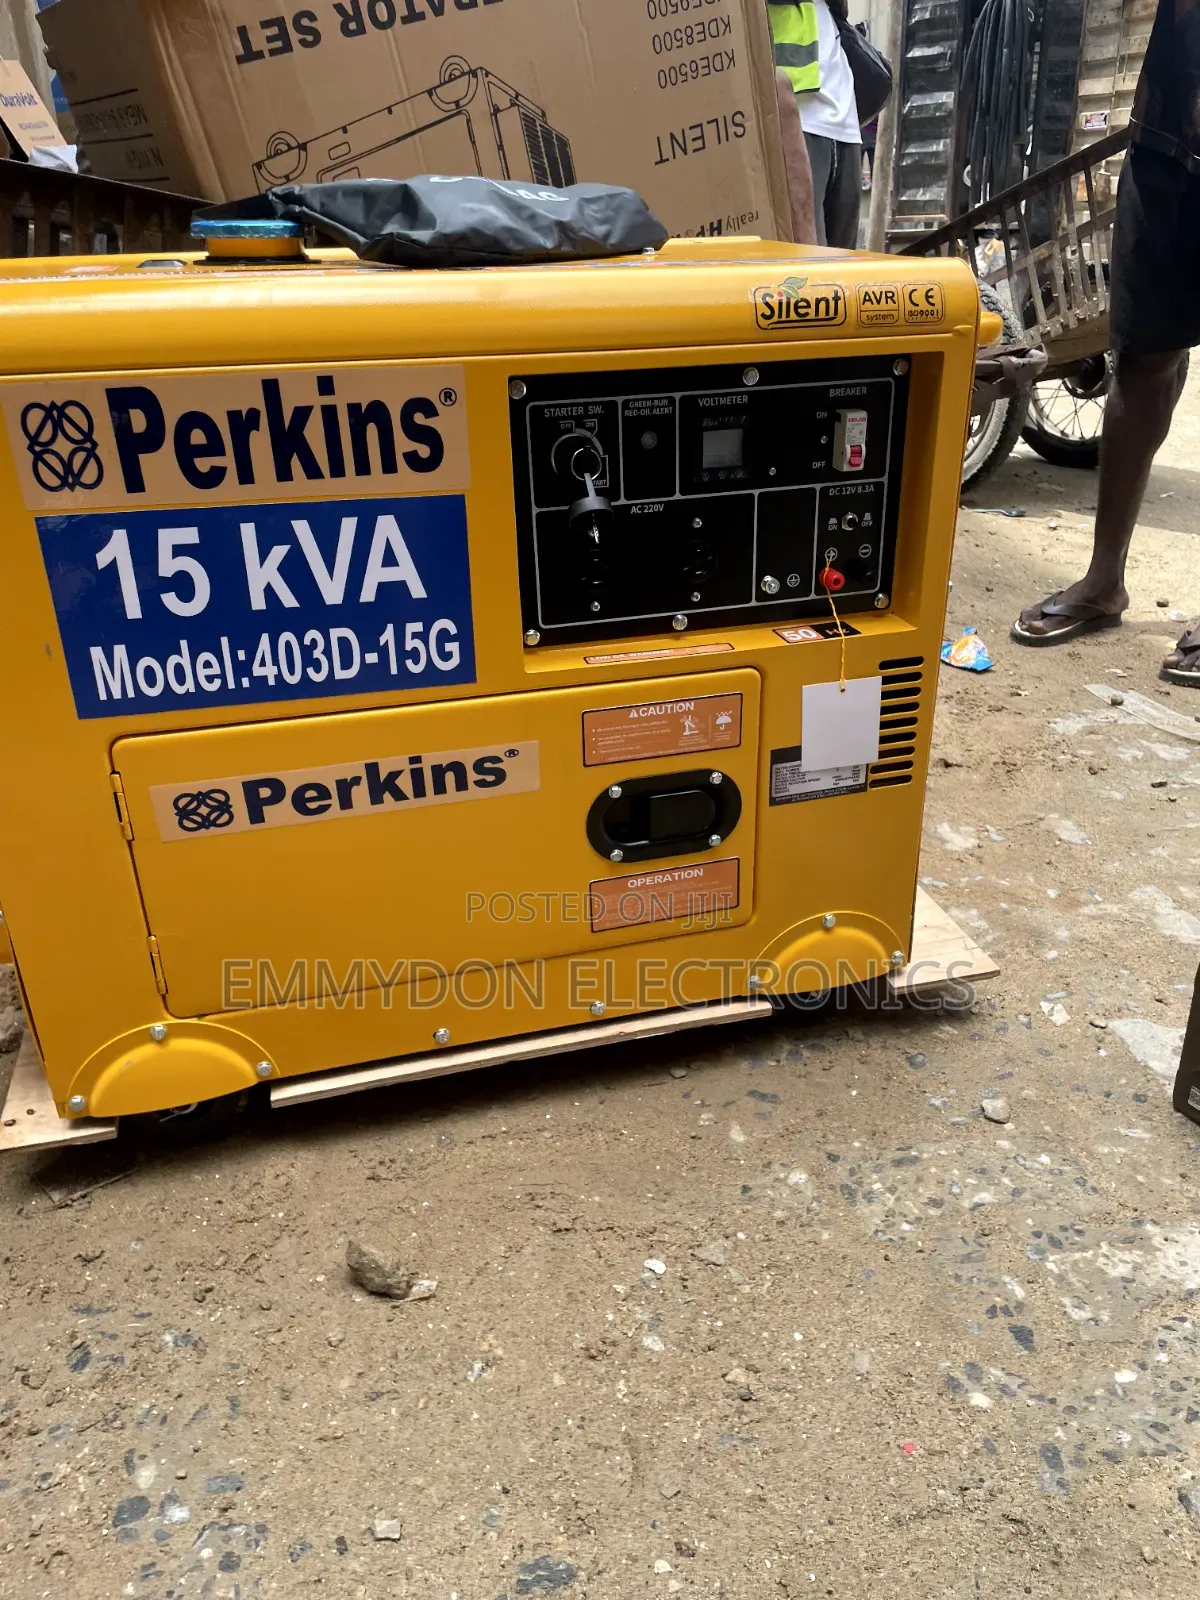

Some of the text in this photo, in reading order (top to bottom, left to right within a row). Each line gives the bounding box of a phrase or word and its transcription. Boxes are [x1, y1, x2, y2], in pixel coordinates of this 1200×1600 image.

[235, 10, 322, 65] SET
[652, 15, 732, 54] KDE8500
[657, 48, 736, 89] KDE6500
[654, 110, 746, 166] SILENT
[726, 210, 759, 232] really
[760, 289, 841, 321] Silent
[861, 290, 897, 306] AVR
[908, 287, 936, 307] CE
[866, 312, 895, 322] system
[829, 386, 868, 397] BREAKER
[698, 395, 748, 407] VOLTMETER
[544, 407, 584, 418] STARTER
[816, 411, 828, 419] ON
[812, 461, 827, 469] OFF
[829, 484, 875, 496] DC 12V 8.3A
[630, 503, 665, 514] AC 220V
[95, 514, 428, 620] 15 kVA
[781, 628, 817, 641] 50
[89, 618, 461, 701] Model:403D-15G
[639, 701, 695, 718] CAUTION
[627, 867, 704, 888] OPERATION
